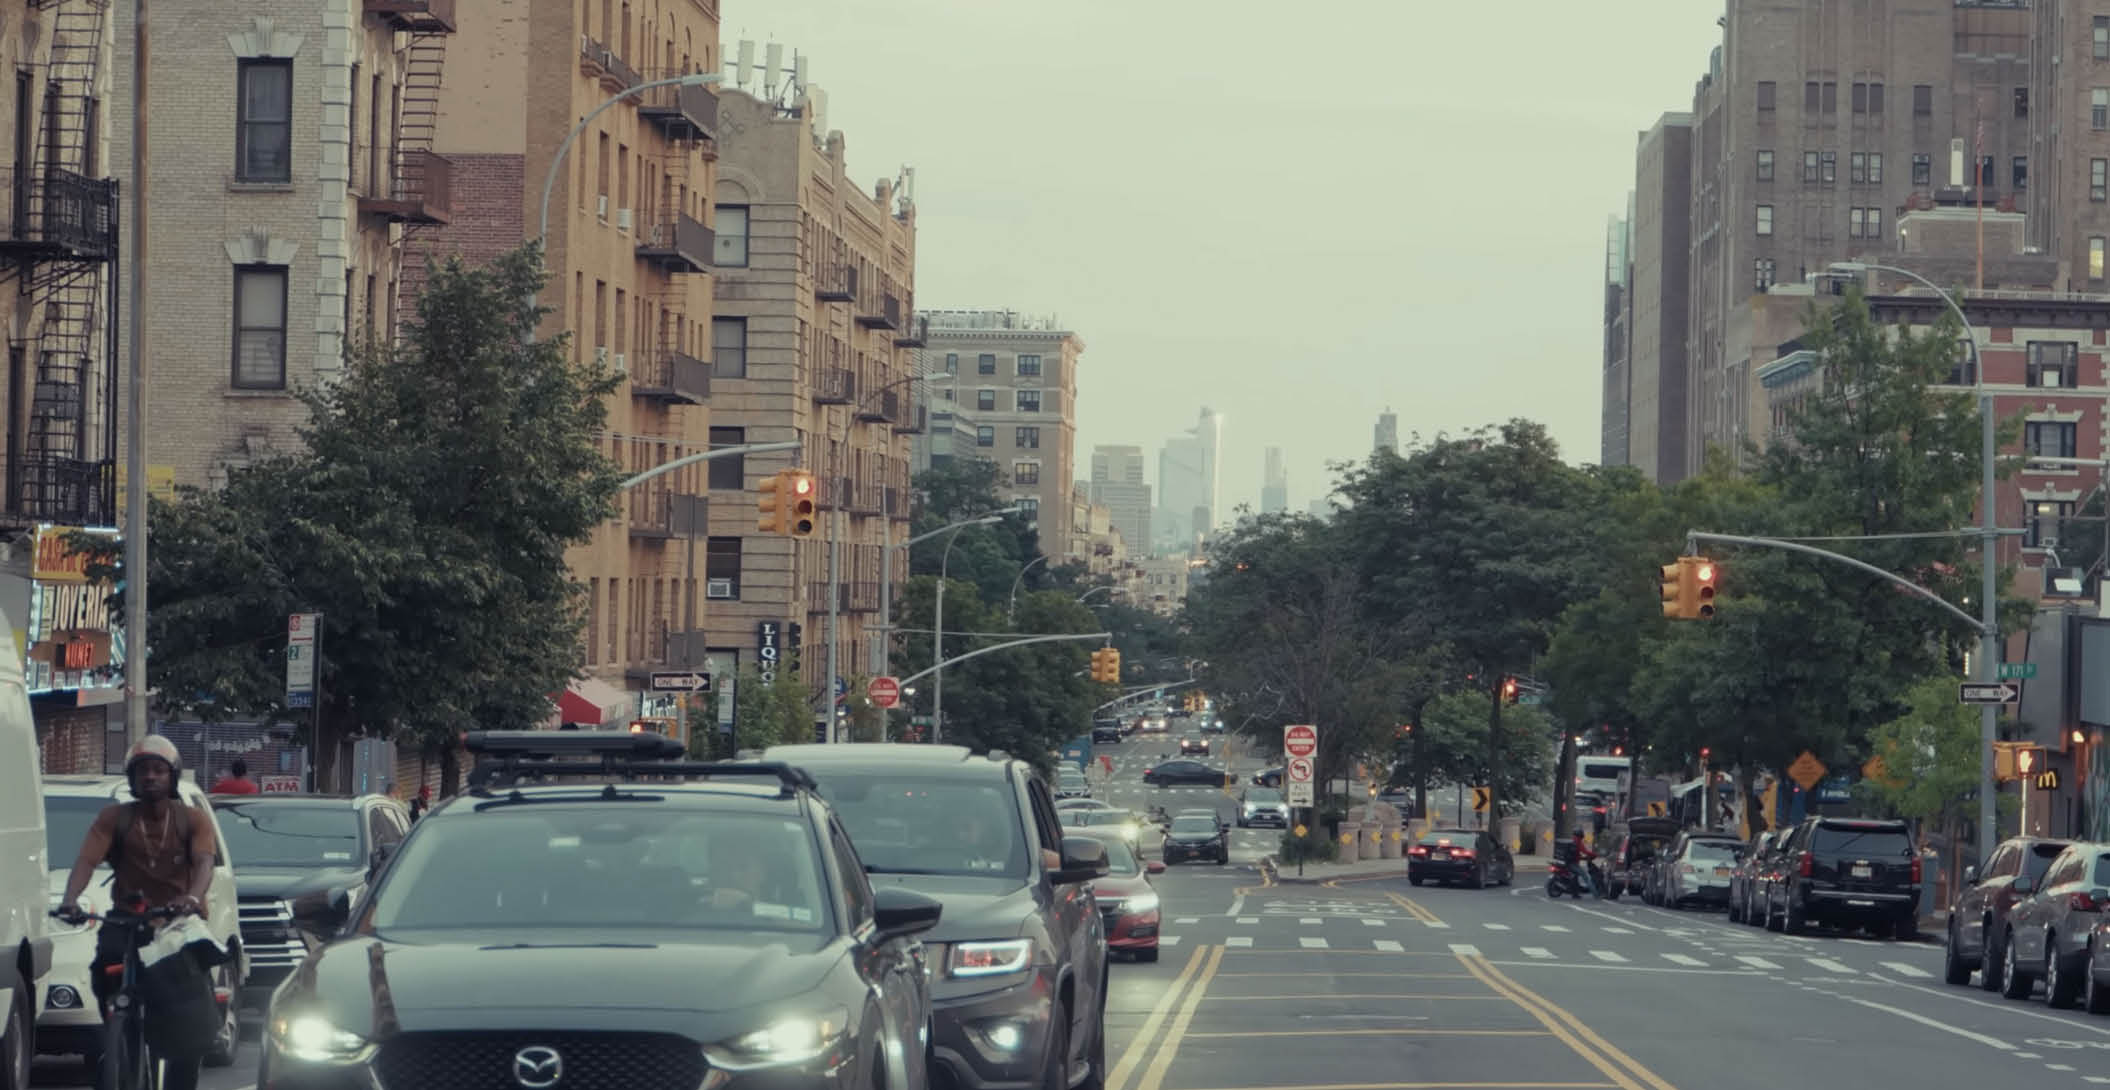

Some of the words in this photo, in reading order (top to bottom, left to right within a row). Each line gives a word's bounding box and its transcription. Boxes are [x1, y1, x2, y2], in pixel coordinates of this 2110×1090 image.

[53, 584, 108, 631] JOYERIA
[2000, 664, 2009, 677] W
[657, 679, 672, 687] ONE
[681, 678, 698, 687] WAY
[1965, 688, 1981, 697] ONE
[1992, 688, 2009, 697] WAY
[264, 782, 298, 792] ATM
